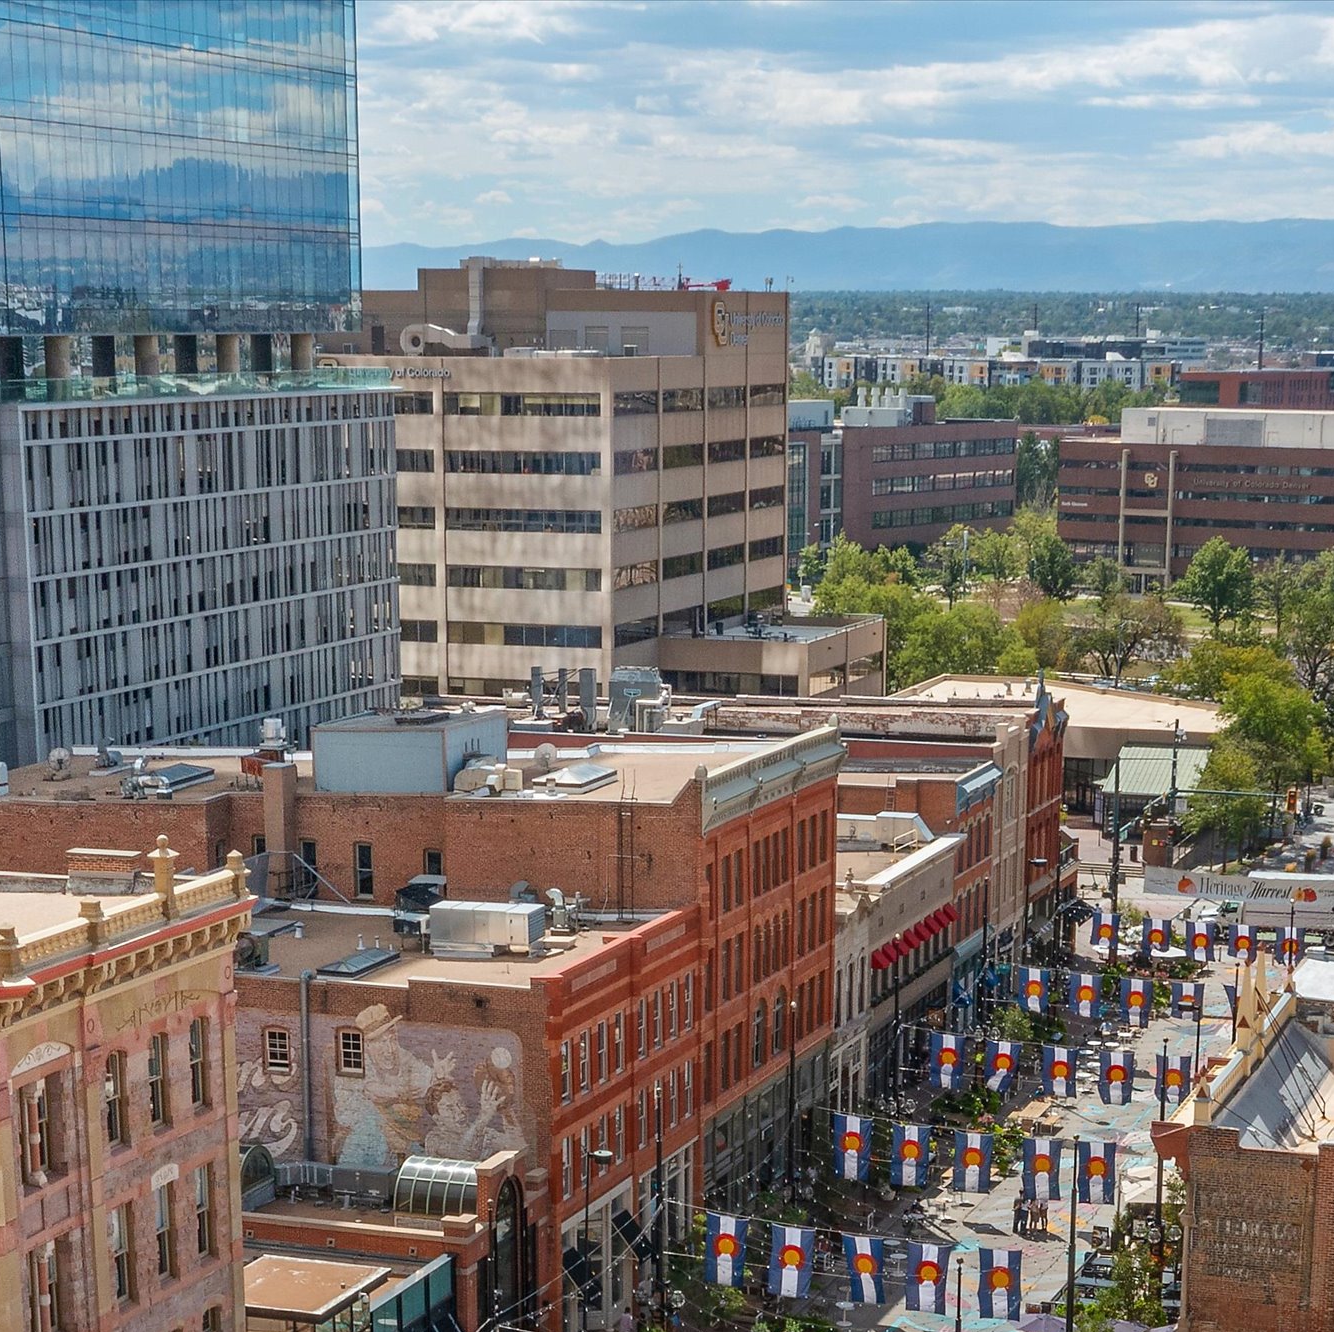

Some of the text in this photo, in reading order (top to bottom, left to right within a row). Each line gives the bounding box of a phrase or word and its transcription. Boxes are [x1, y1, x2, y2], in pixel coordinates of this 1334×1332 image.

[395, 367, 405, 378] of
[406, 366, 451, 378] Colorado
[1244, 479, 1280, 489] Colorado
[1199, 877, 1292, 900] Heritage Harvest
